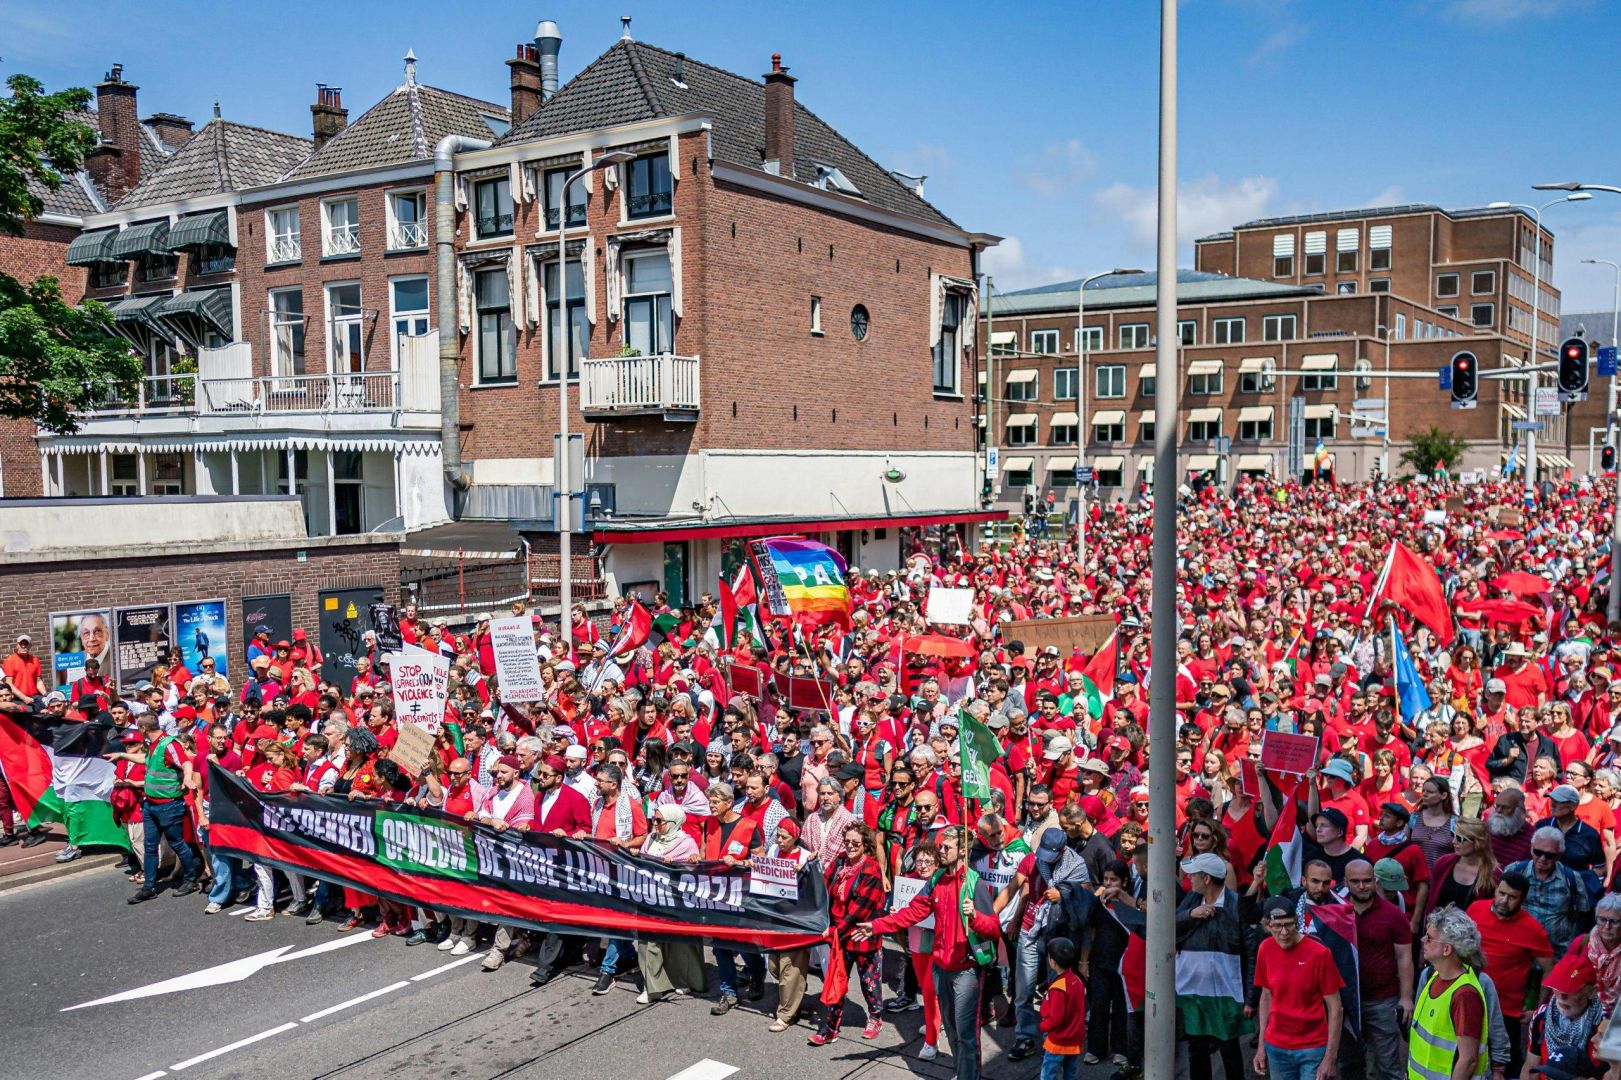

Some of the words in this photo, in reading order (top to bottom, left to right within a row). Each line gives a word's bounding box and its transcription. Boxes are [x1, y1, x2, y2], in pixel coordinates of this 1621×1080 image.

[398, 664, 422, 678] STOP
[397, 688, 434, 703] VIOLENCE
[382, 818, 468, 872] OPNIEUW
[473, 833, 503, 878] DE
[503, 842, 560, 888] RODE
[612, 863, 676, 907] VOOR
[678, 874, 746, 913] GAZA
[752, 855, 770, 864] GAZA
[771, 859, 795, 869] NEEDS
[752, 864, 796, 880] MEDICINE
[901, 884, 917, 895] EEN
